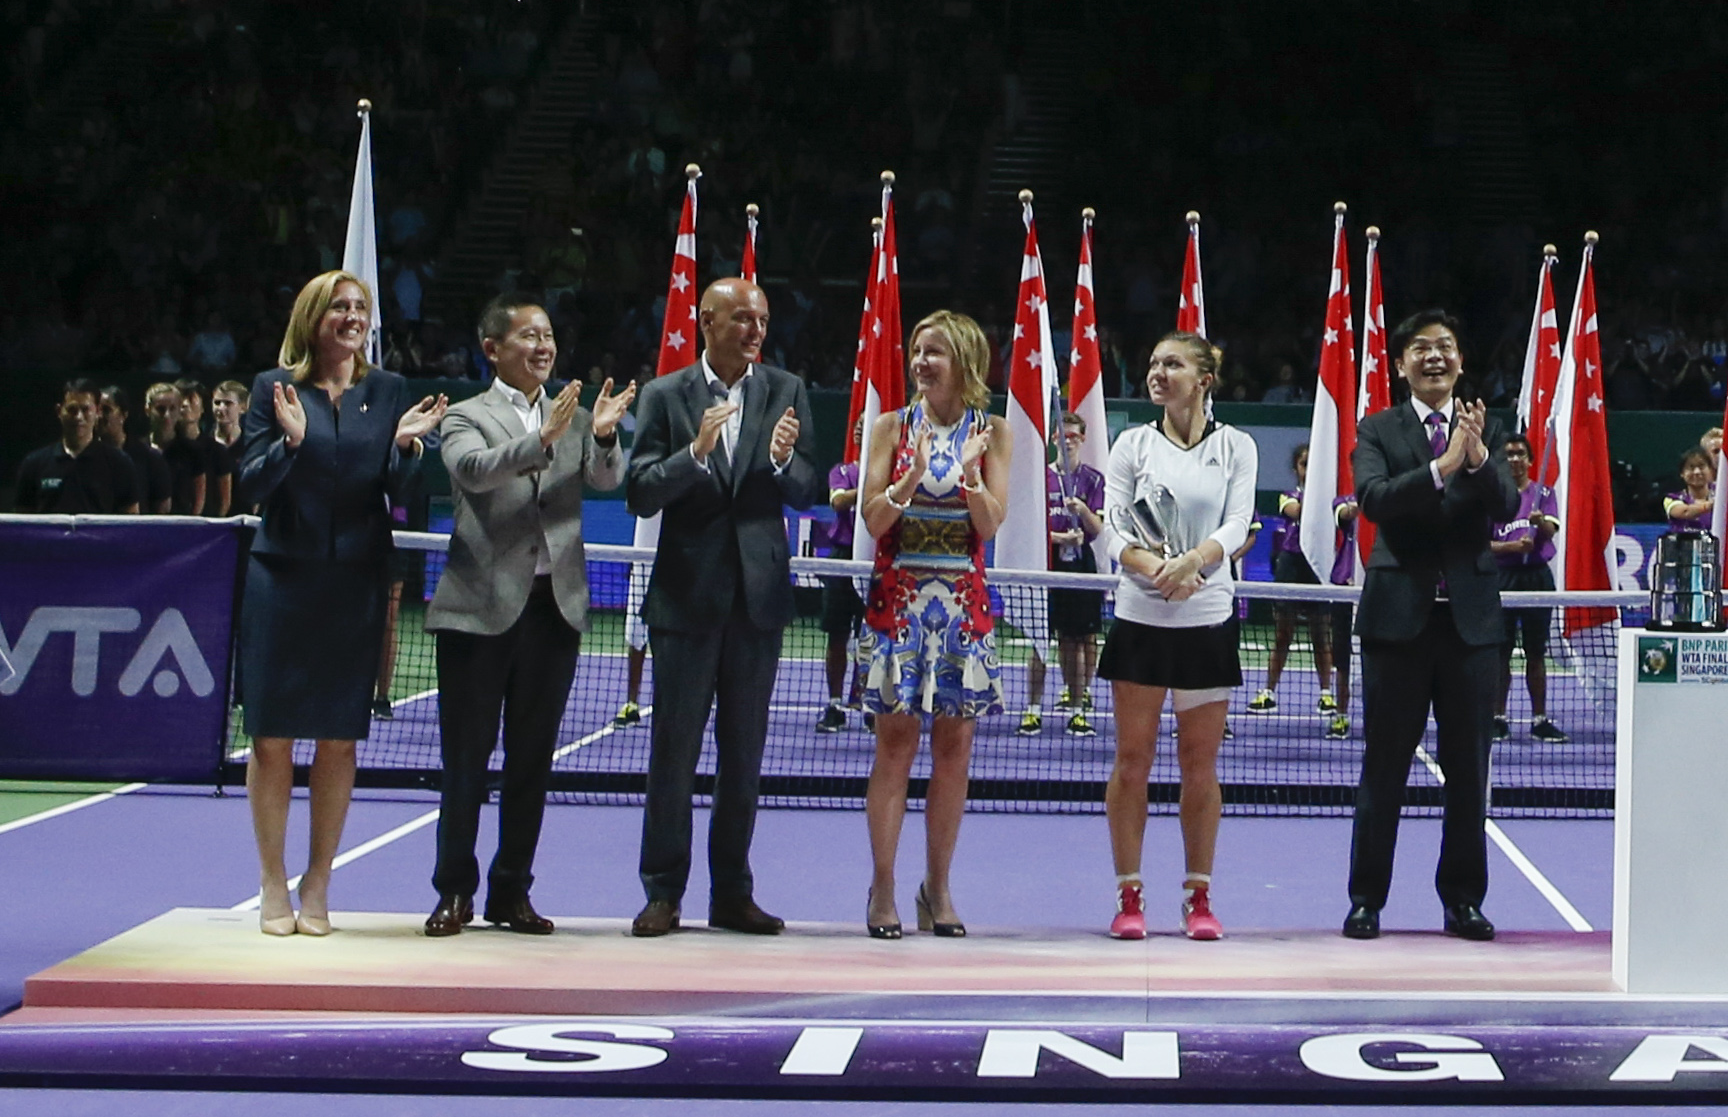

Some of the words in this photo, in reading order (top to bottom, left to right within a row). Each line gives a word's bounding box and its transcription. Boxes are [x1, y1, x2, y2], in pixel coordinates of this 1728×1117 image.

[1682, 639, 1702, 652] BNP
[1682, 653, 1700, 663] WTA
[1682, 665, 1728, 675] SINGAPORE
